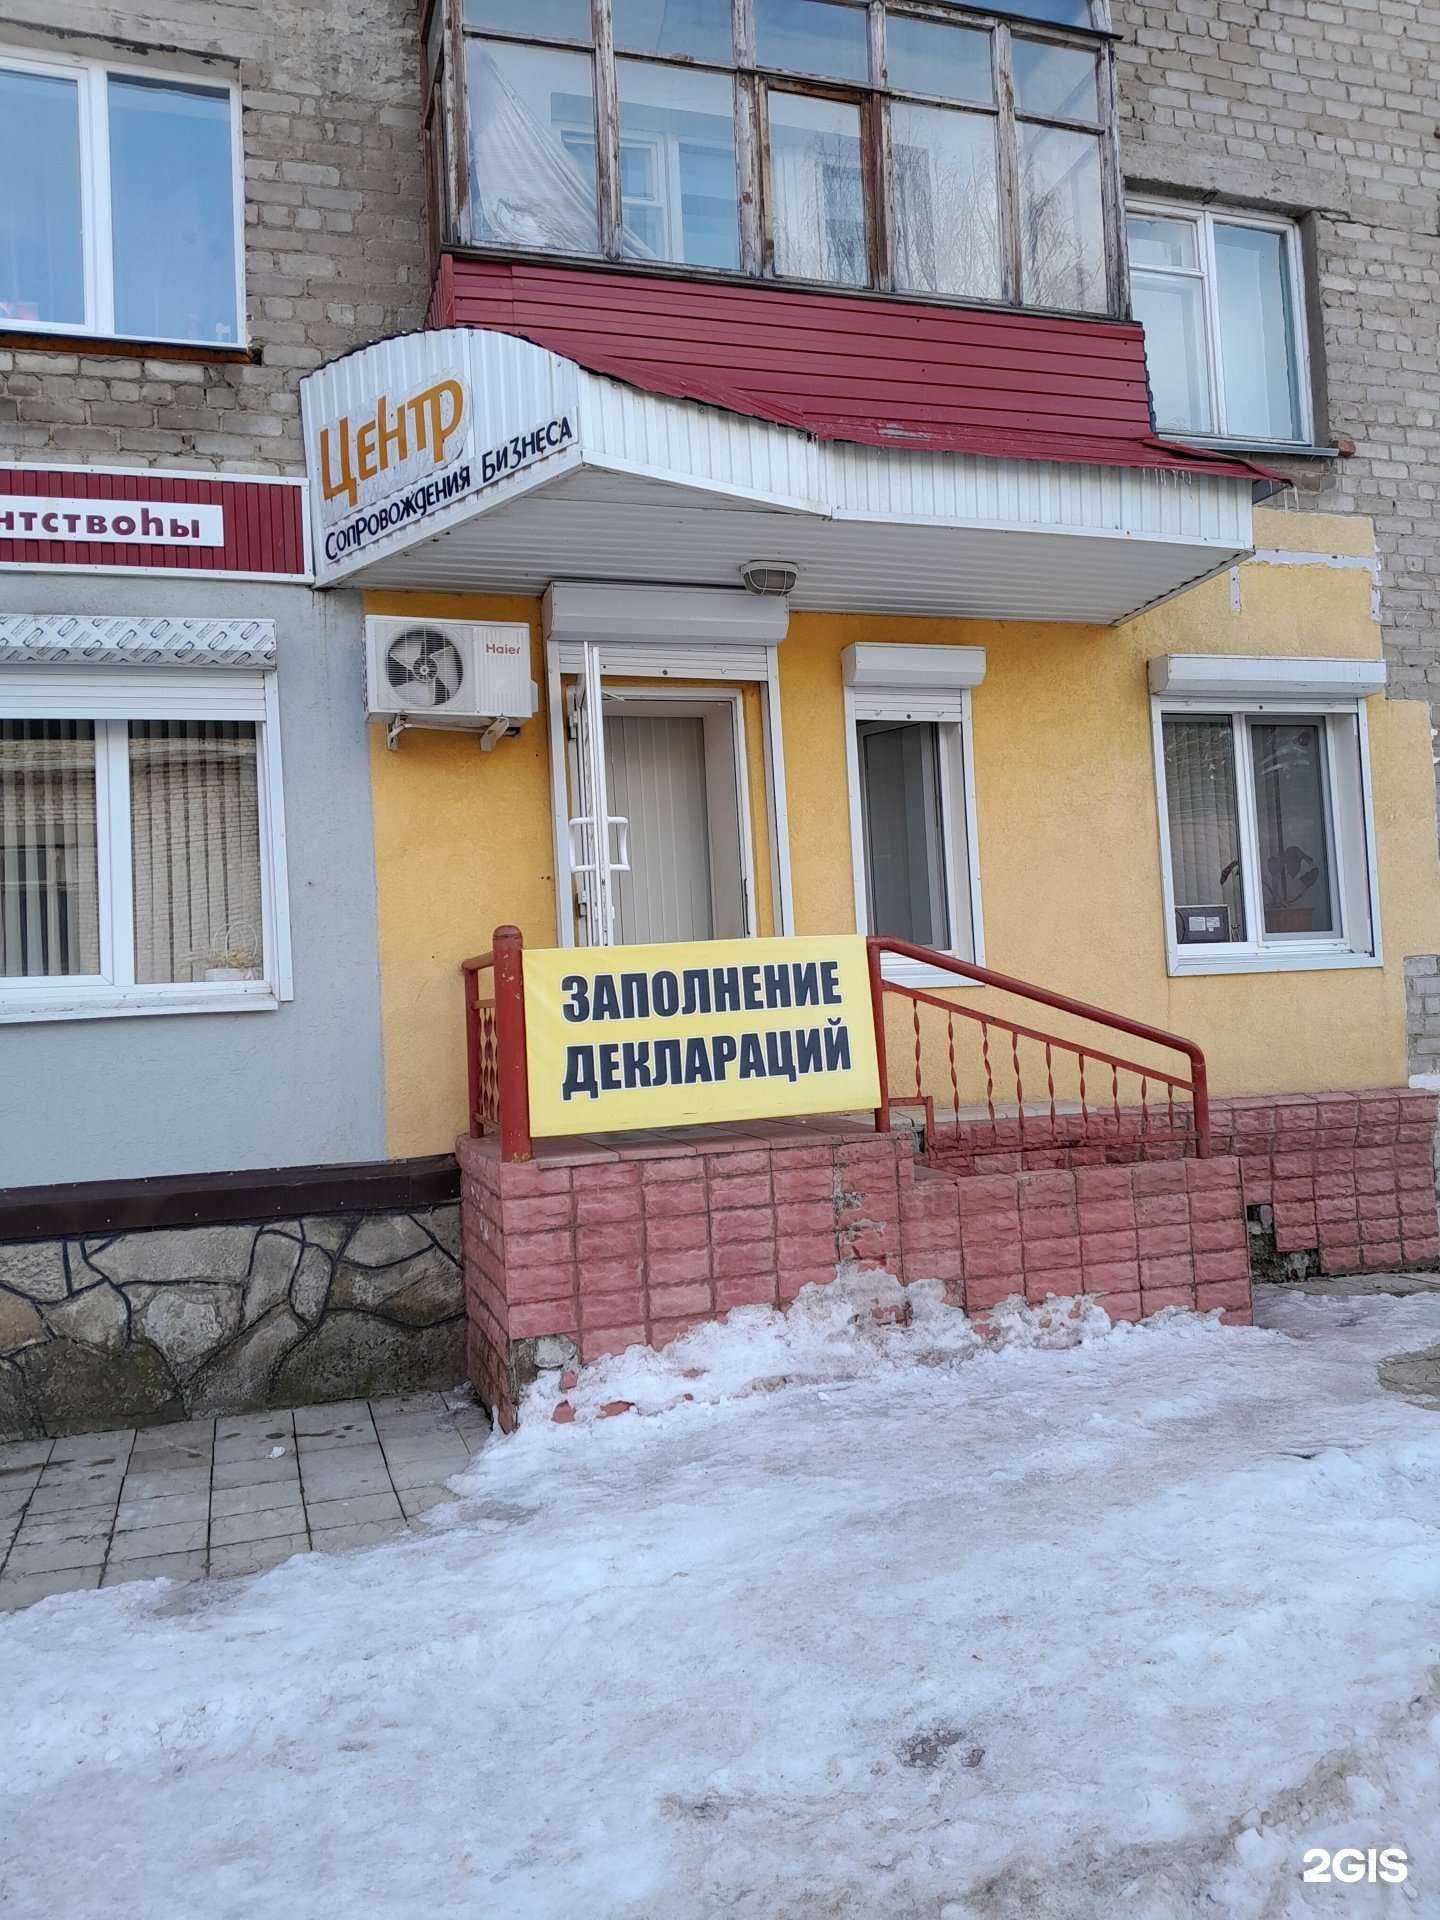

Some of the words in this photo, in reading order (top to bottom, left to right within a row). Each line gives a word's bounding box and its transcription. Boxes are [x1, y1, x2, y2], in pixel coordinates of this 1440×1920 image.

[485, 643, 521, 655] Haier
[561, 961, 842, 1023] ЗАПОЛНЕНИЕ
[562, 1017, 852, 1101] ДЕКЛАРАЦИЙ
